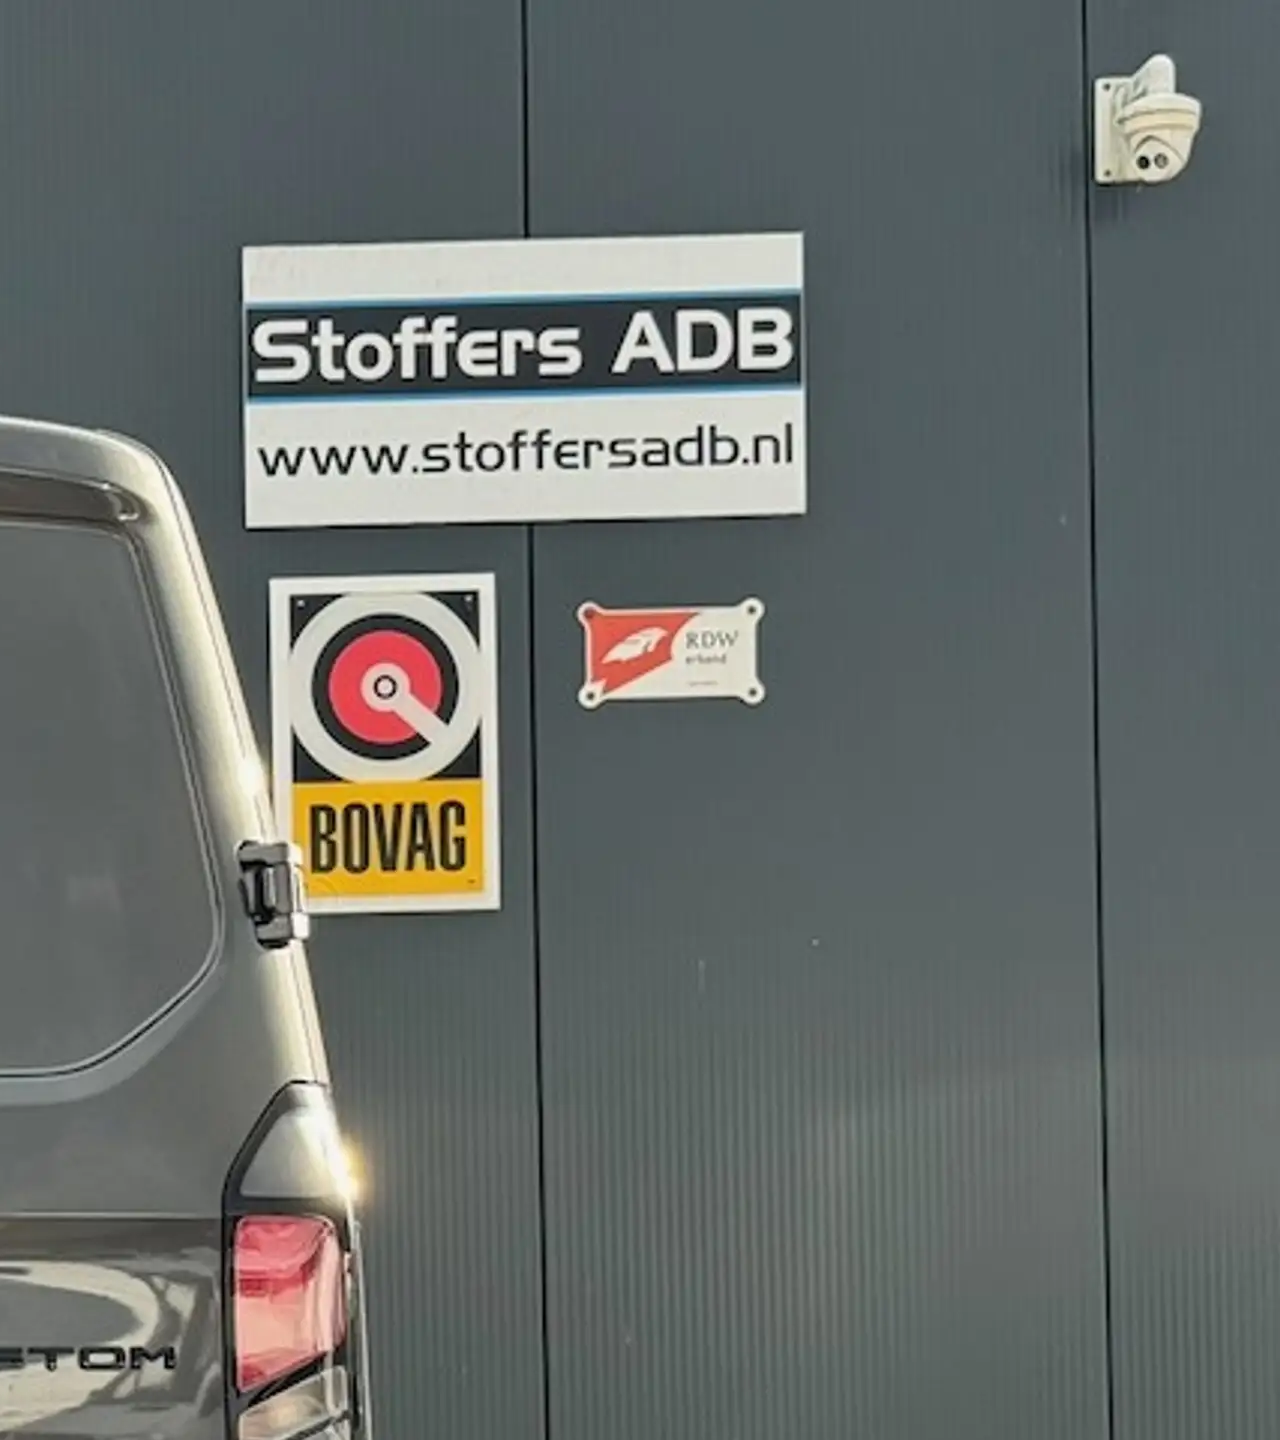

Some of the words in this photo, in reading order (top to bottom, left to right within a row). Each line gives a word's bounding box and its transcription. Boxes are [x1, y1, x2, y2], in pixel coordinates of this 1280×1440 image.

[251, 315, 582, 383] Stoffers
[611, 306, 794, 374] ADB
[258, 424, 793, 477] www.stoffersadb.nl
[685, 629, 739, 649] RDW
[309, 799, 467, 875] BOVAG
